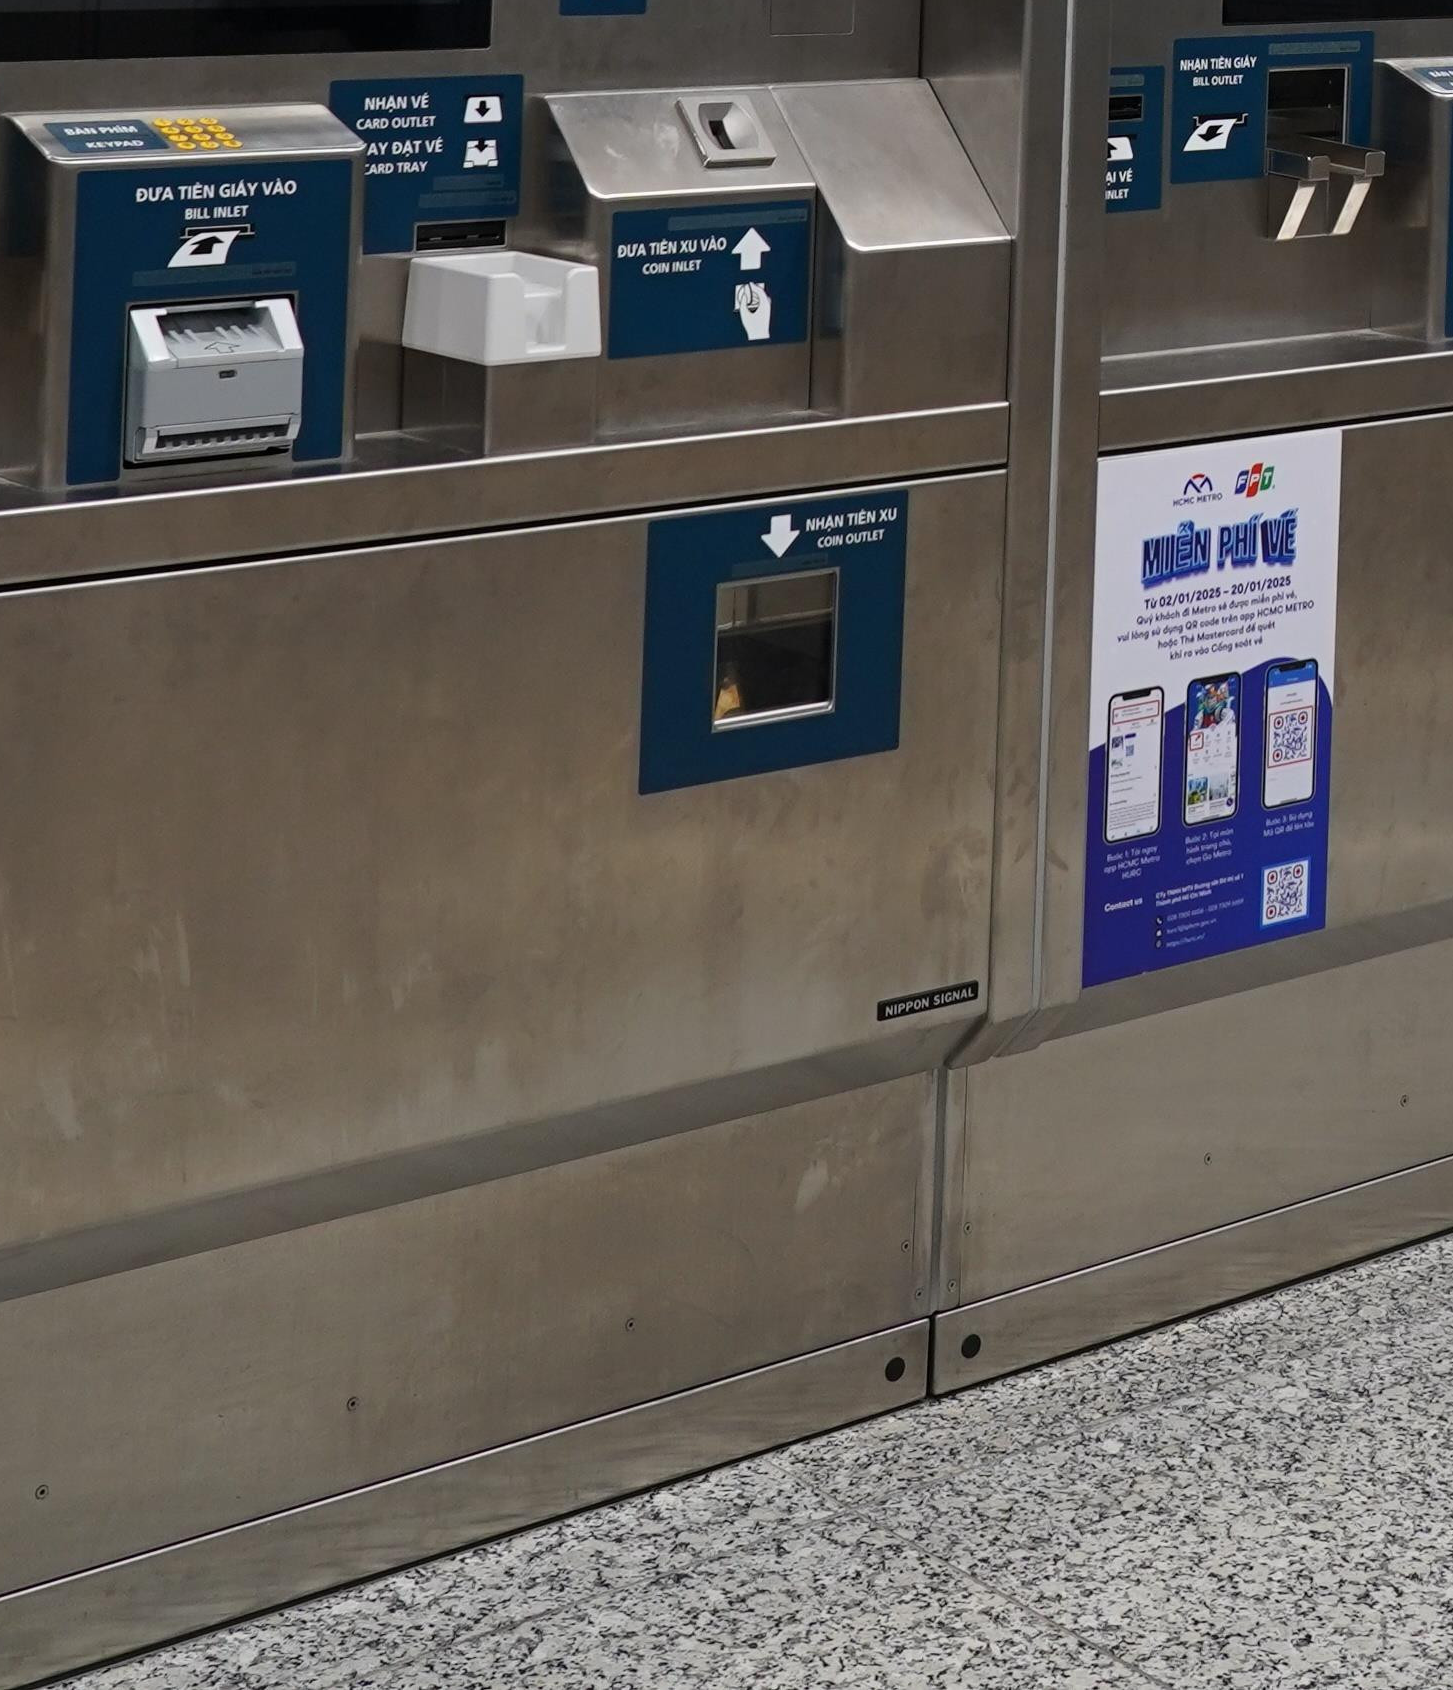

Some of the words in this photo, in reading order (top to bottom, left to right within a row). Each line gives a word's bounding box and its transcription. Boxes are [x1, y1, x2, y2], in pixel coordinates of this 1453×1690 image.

[356, 118, 389, 130] CARD
[391, 116, 436, 129] OUTLET
[85, 140, 144, 148] KEYPAD
[136, 186, 174, 202] ĐƯA
[262, 178, 297, 196] VÀO
[184, 207, 211, 220] BILL
[213, 205, 249, 218] INLET
[617, 243, 646, 258] ĐƯA
[679, 240, 697, 253] XU
[700, 235, 727, 252] VÀO
[642, 262, 670, 275] COIN
[672, 259, 702, 272] INLET
[1235, 463, 1275, 498] FPT
[878, 507, 897, 522] XU
[817, 534, 844, 548] COIN
[845, 528, 885, 544] OUTLET
[885, 997, 929, 1017] NIPPON
[933, 987, 974, 1006] SIGNAL
